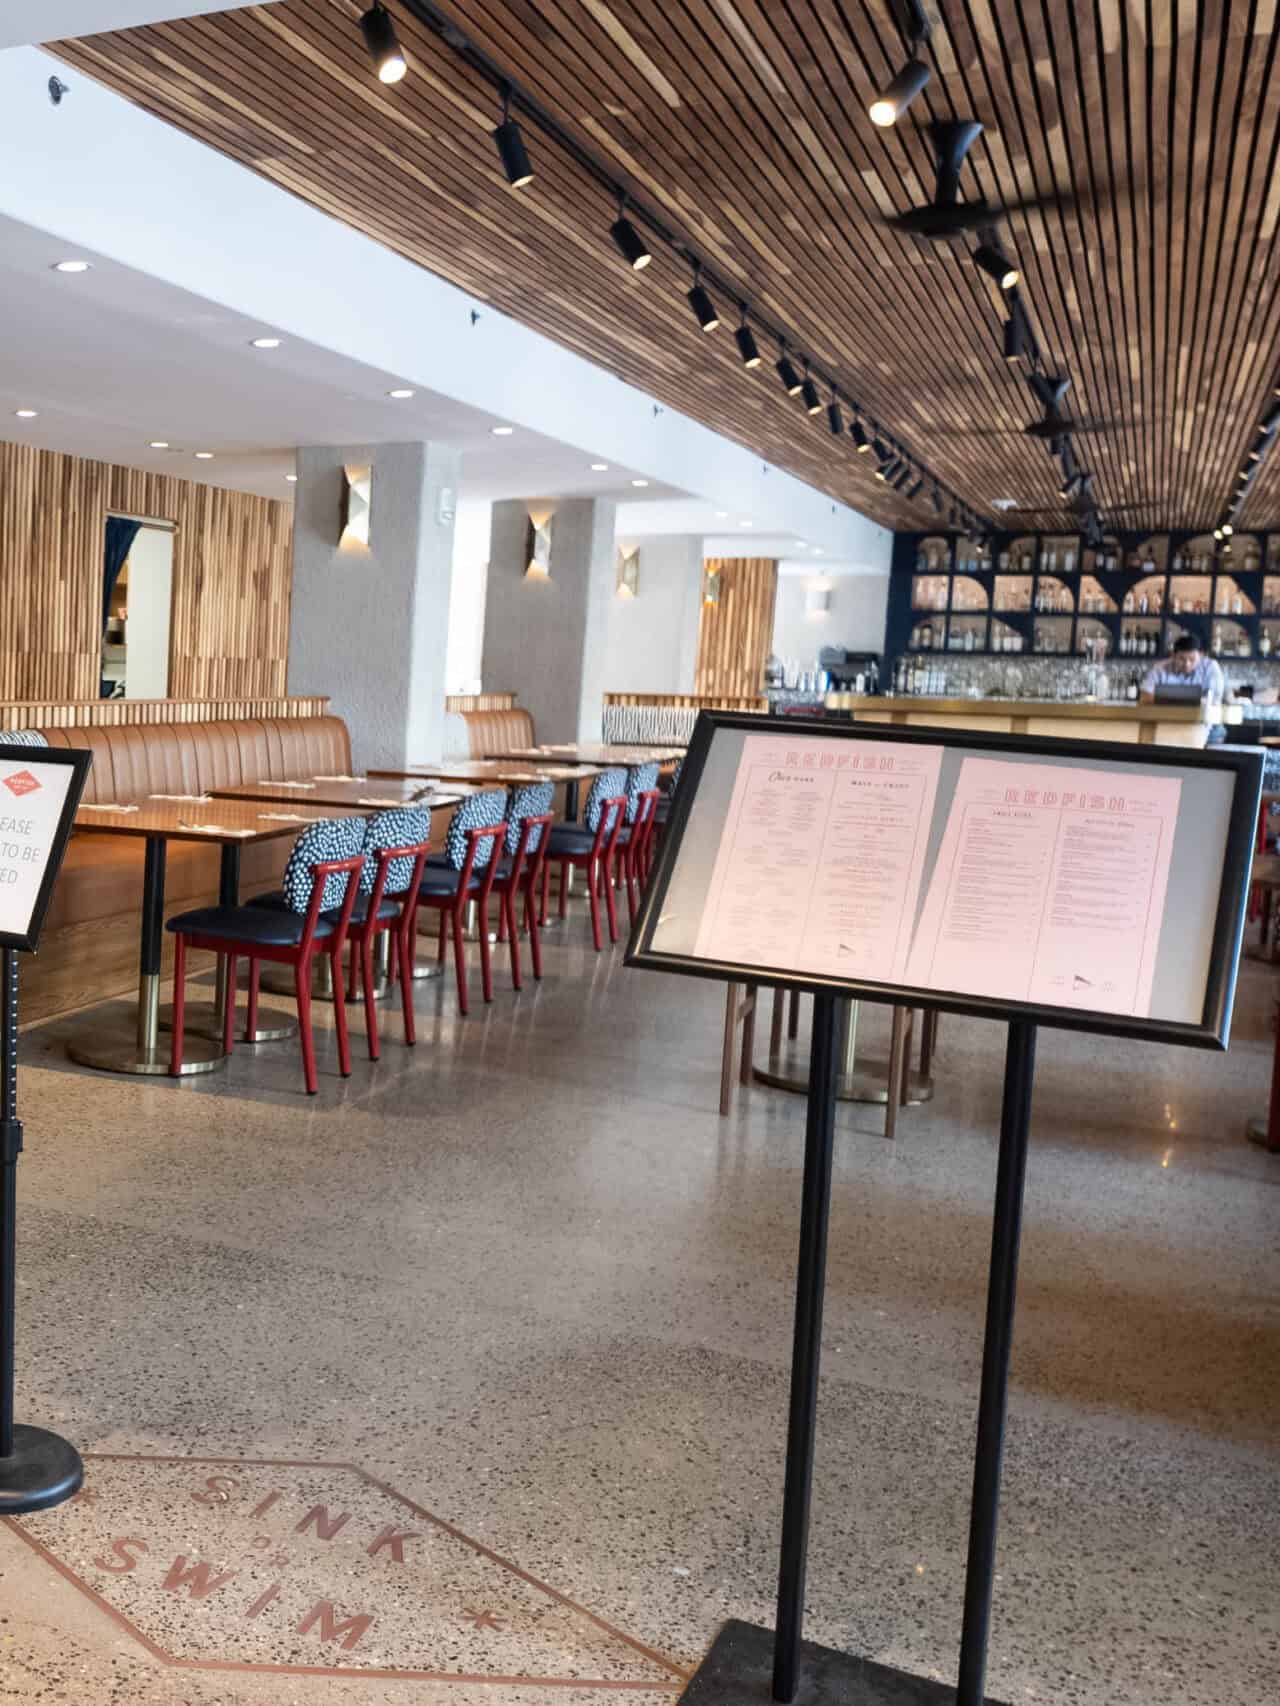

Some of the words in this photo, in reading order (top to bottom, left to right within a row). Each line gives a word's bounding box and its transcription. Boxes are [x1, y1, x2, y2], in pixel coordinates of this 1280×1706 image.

[1, 841, 19, 858] TO
[22, 846, 41, 862] BE
[190, 1475, 420, 1563] SINK
[94, 1537, 376, 1650] SWIM
